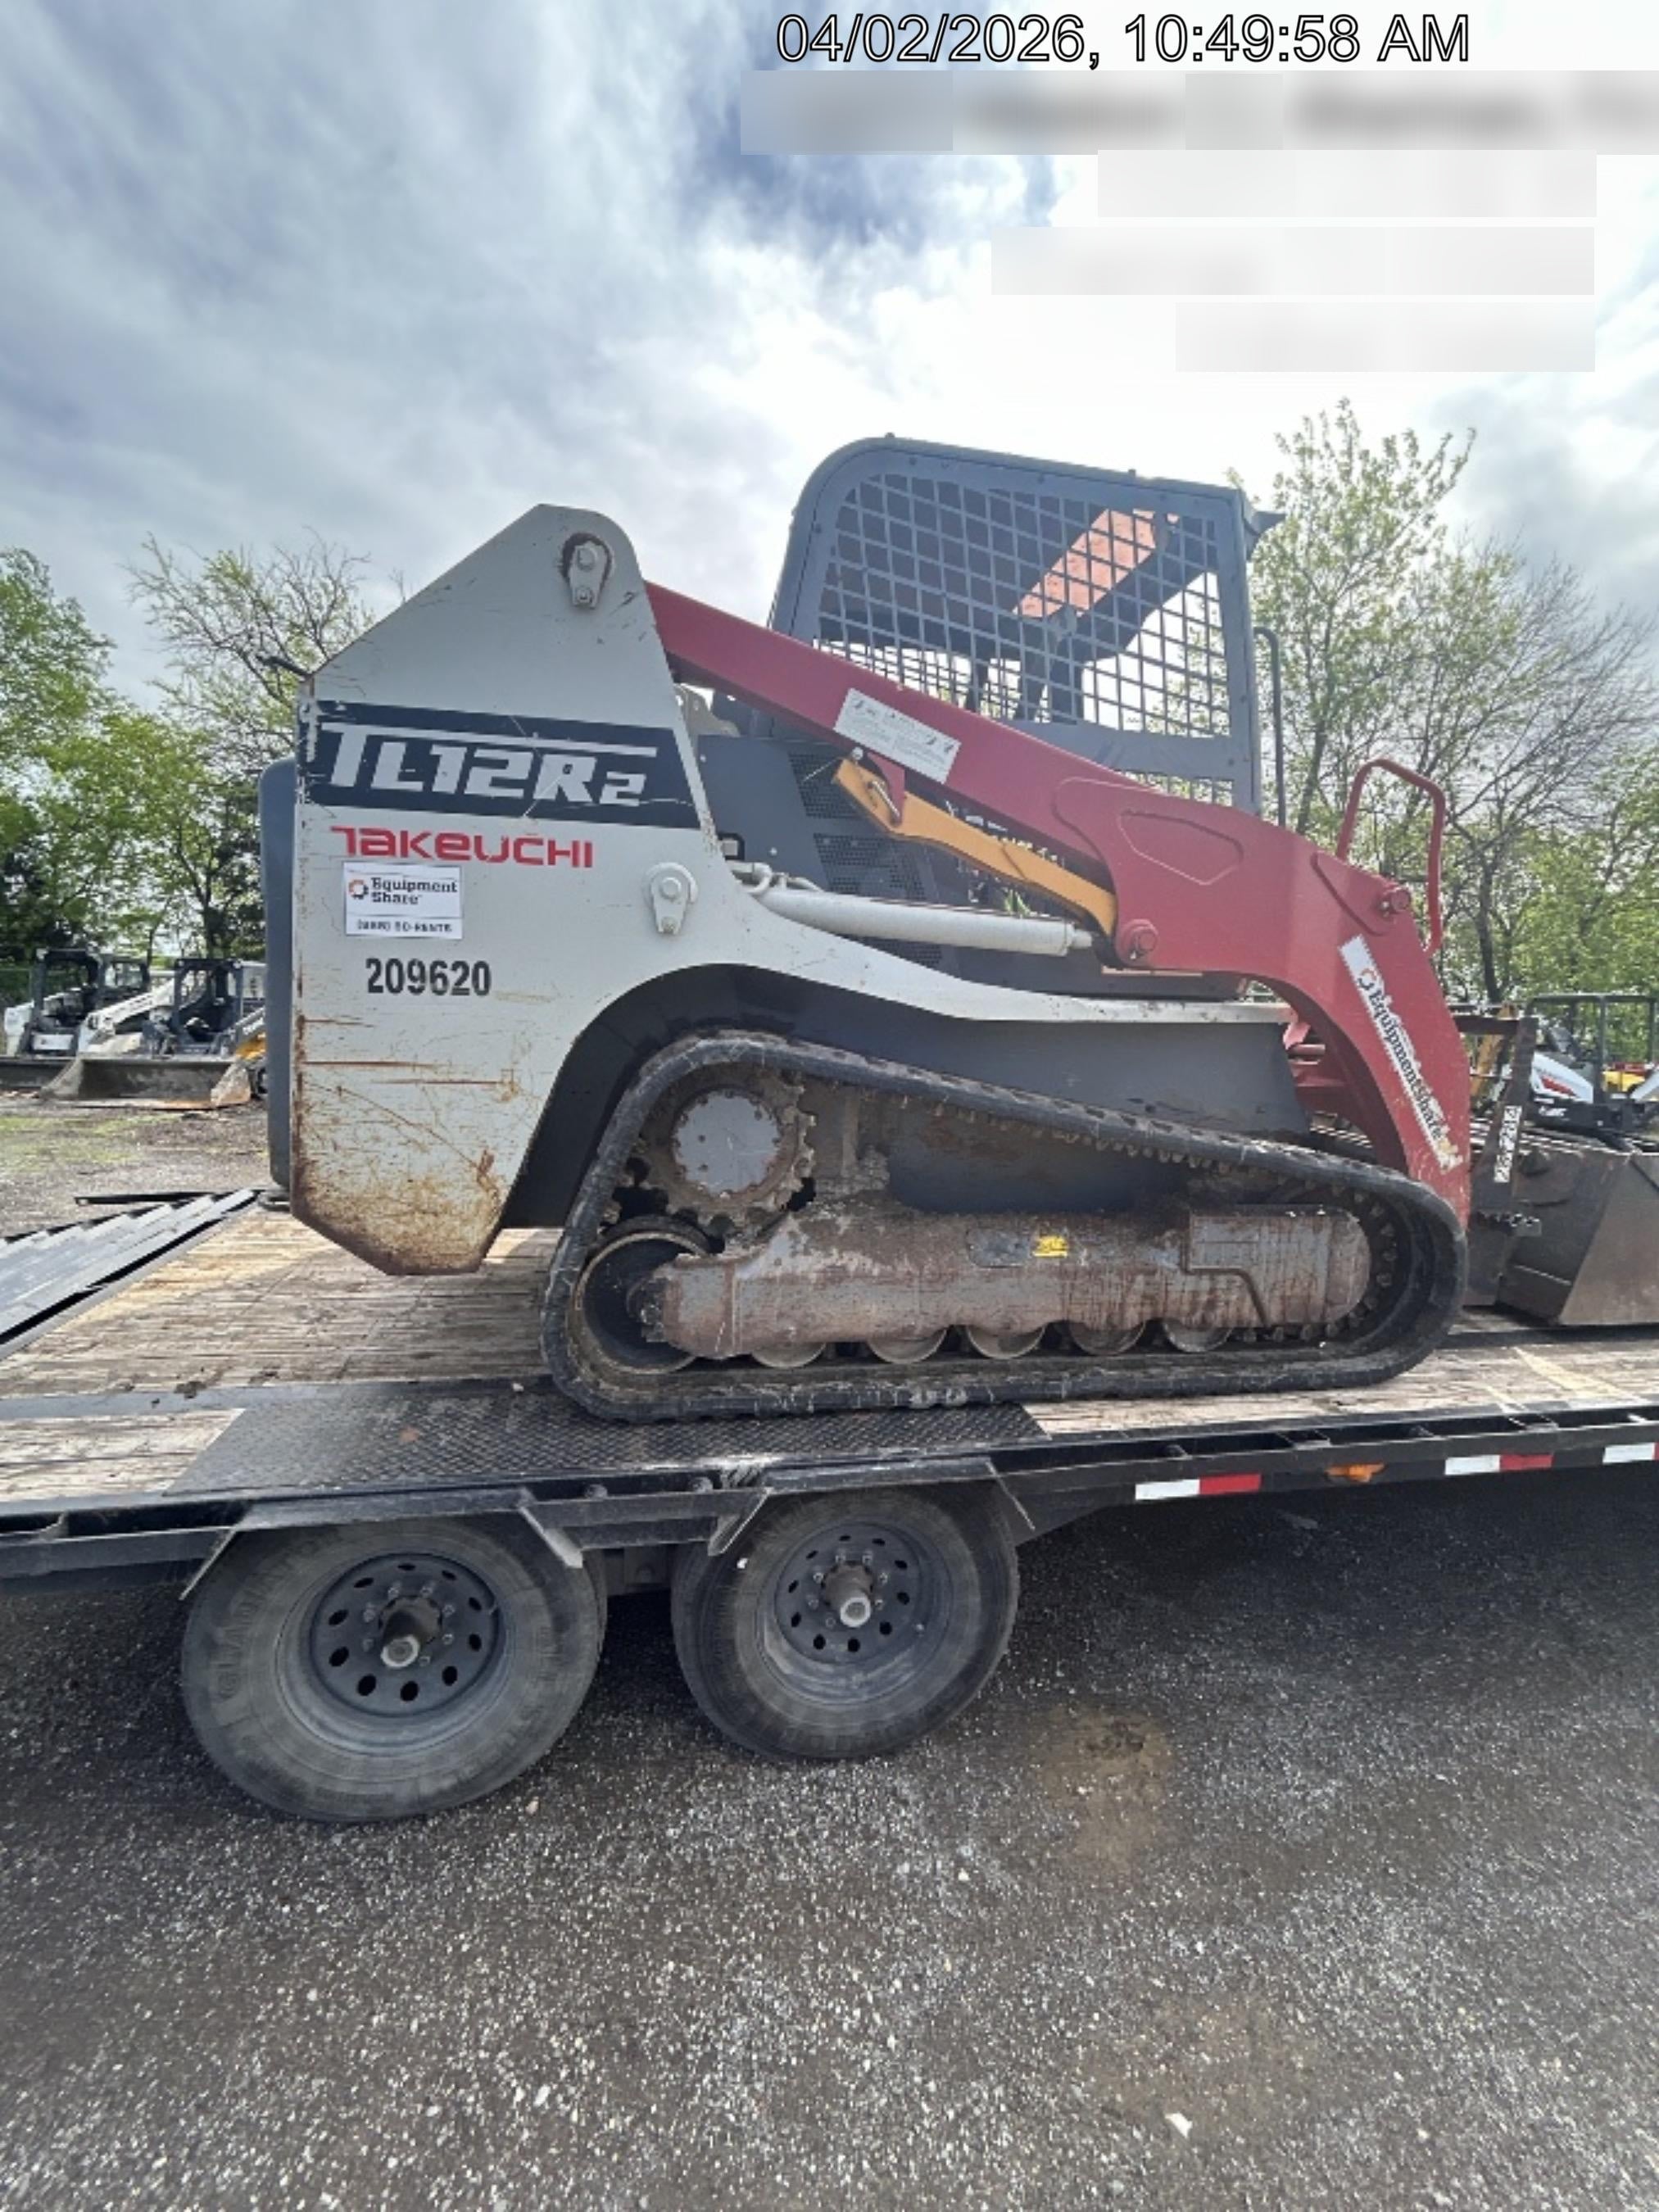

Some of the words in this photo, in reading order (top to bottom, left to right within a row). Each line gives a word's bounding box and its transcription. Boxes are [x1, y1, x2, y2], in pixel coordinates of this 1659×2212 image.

[321, 723, 657, 806] TL12R2
[370, 877, 458, 893] Equipment
[371, 891, 419, 905] Share
[365, 957, 492, 996] 209620
